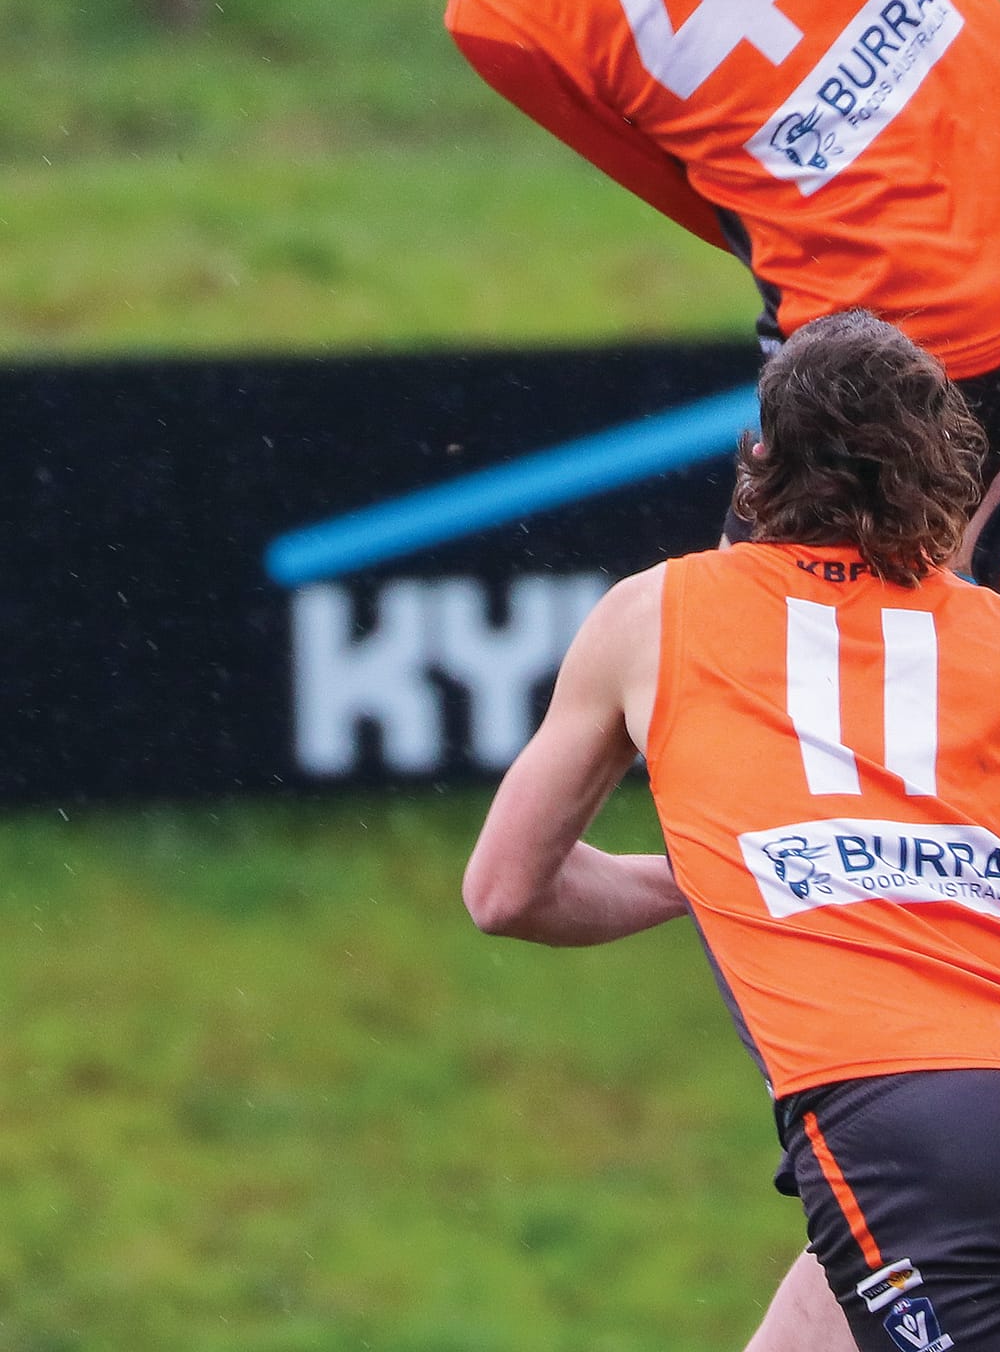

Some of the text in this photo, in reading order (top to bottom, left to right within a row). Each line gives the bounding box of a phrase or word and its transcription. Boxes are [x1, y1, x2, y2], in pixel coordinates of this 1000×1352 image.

[796, 560, 881, 583] KBF
[785, 596, 938, 797] 11
[847, 872, 919, 891] OODS
